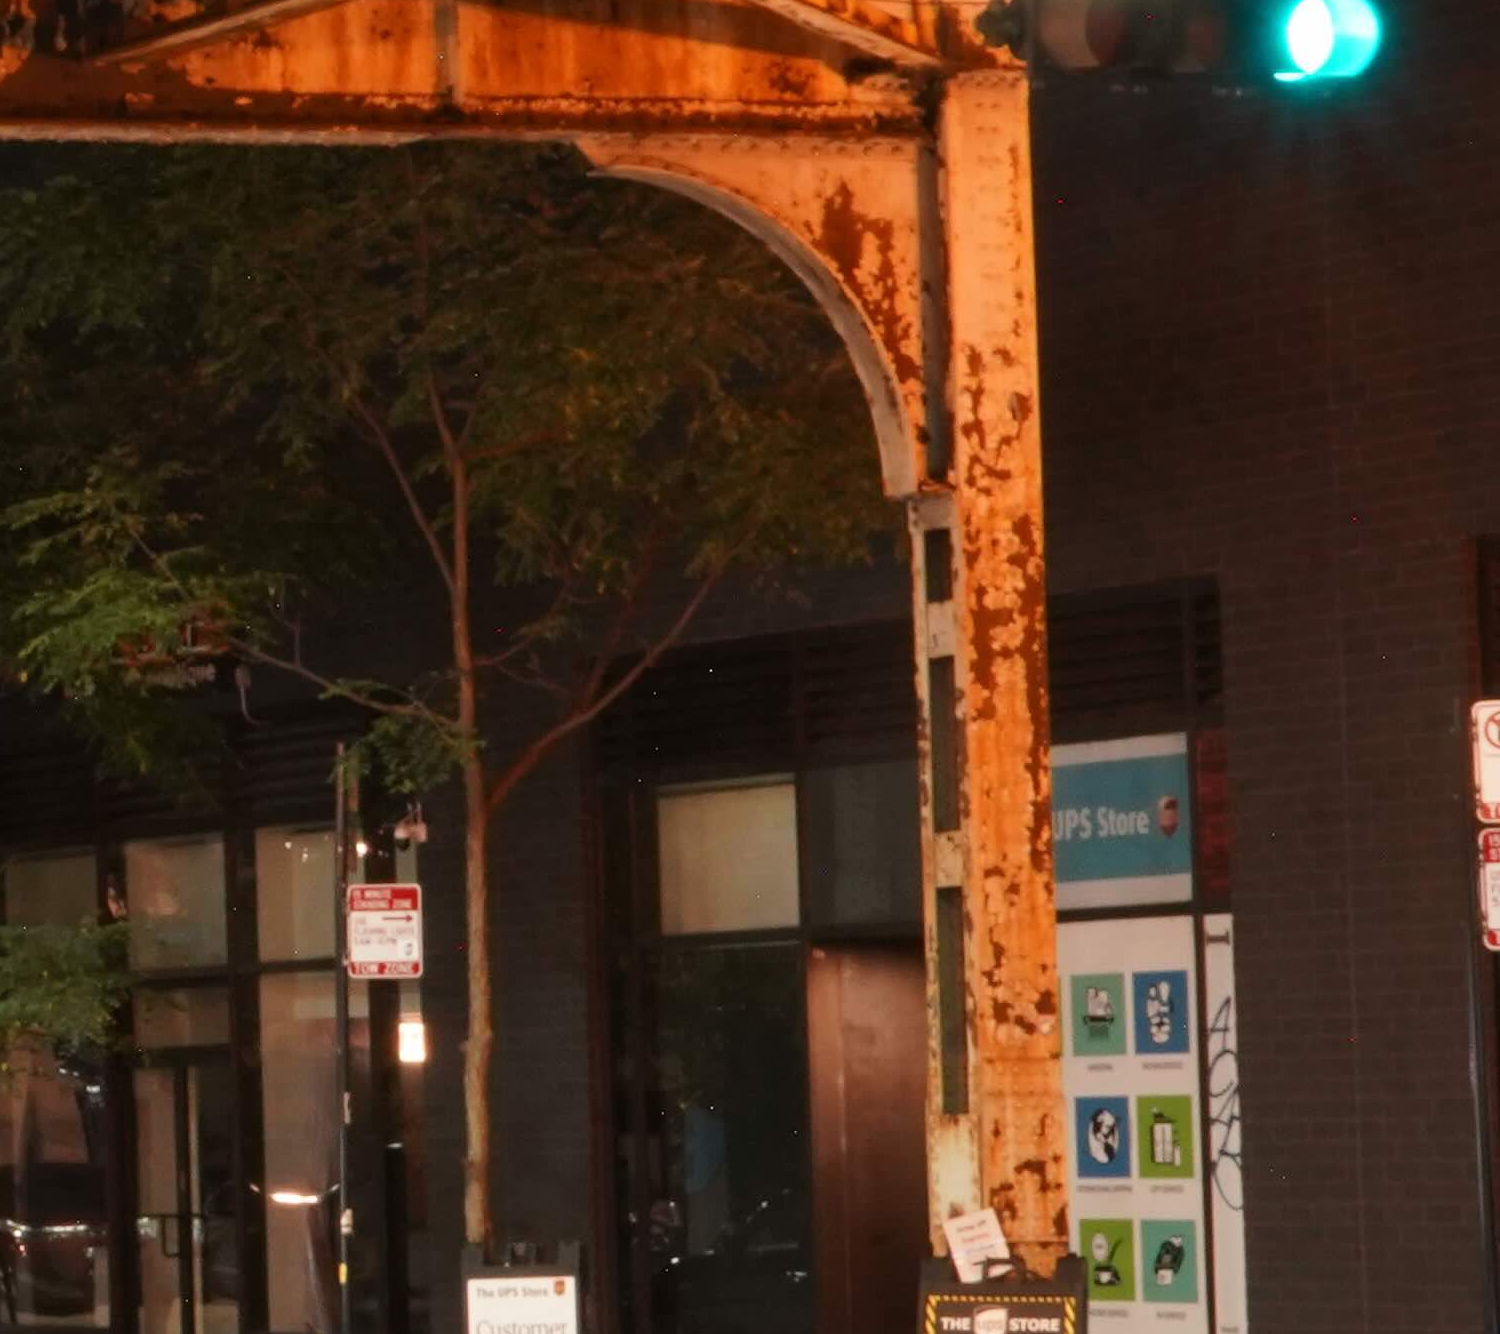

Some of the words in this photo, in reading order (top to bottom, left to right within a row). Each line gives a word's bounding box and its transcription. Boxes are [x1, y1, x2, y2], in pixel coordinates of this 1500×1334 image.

[1097, 807, 1149, 837] Store
[477, 1287, 494, 1297] The
[498, 1286, 518, 1297] UPS
[522, 1285, 549, 1297] Store
[940, 1316, 970, 1331] THE
[1009, 1318, 1060, 1333] STORE
